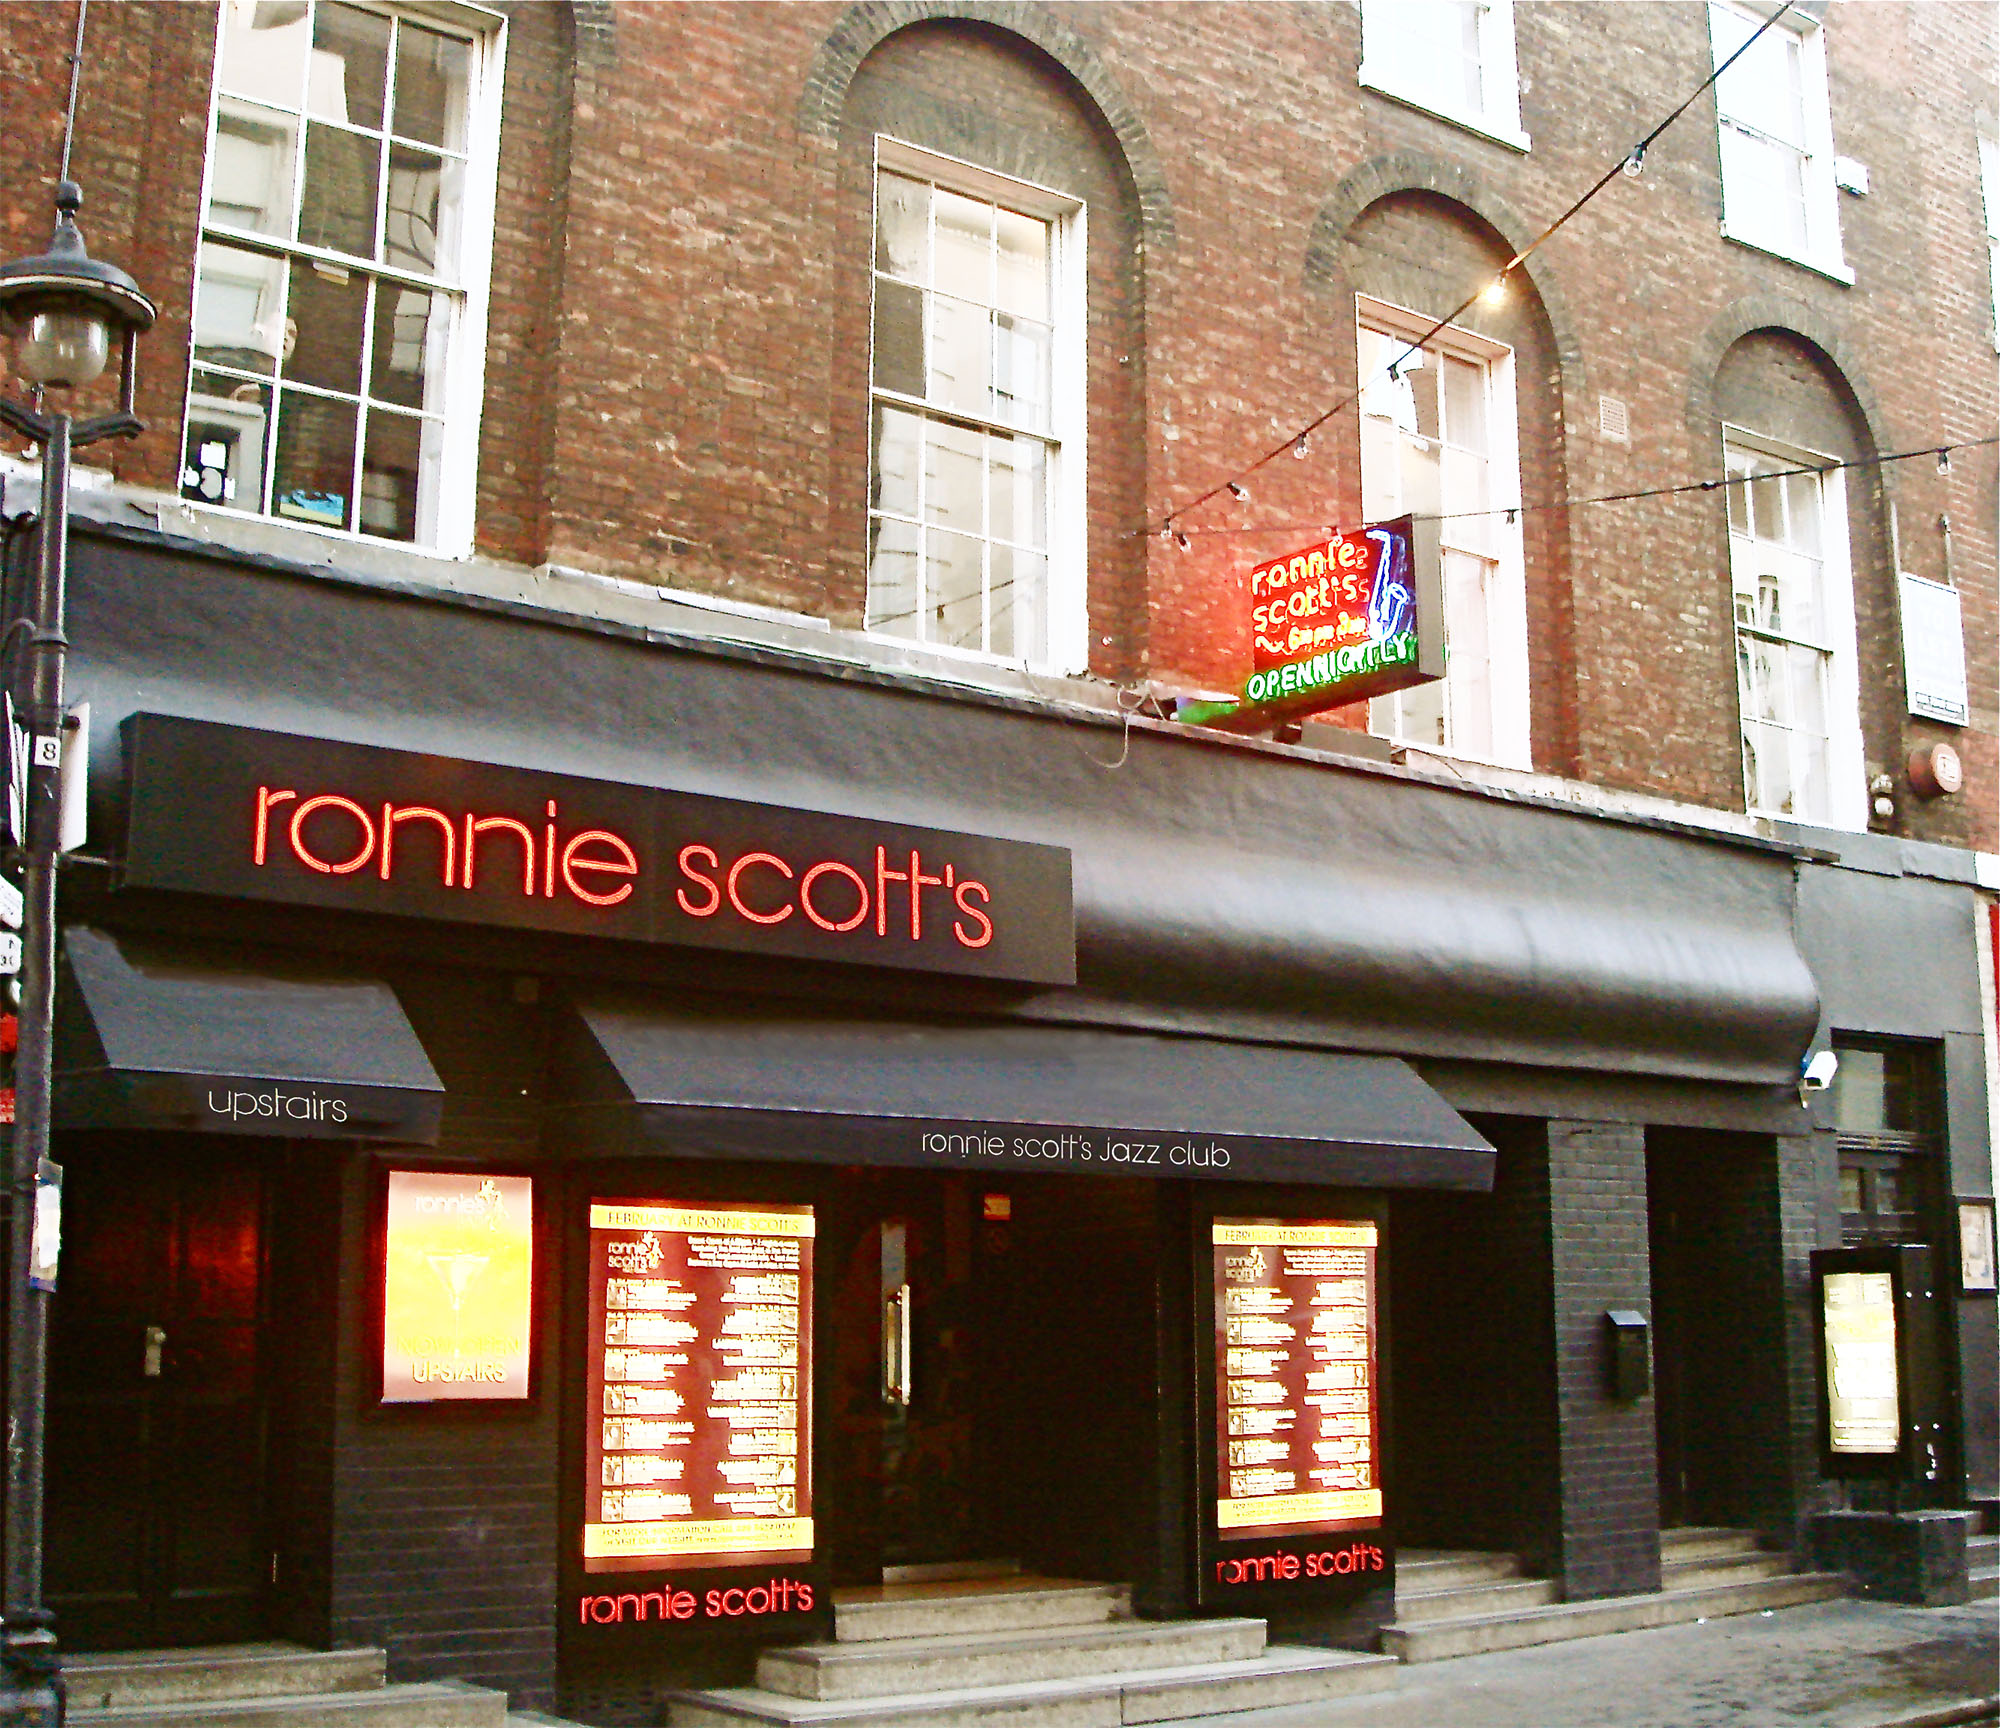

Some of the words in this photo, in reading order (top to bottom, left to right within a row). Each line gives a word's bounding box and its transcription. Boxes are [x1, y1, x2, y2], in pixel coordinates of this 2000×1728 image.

[1252, 536, 1355, 595] ronnie
[1252, 574, 1358, 632] scott's
[42, 742, 57, 761] 8
[255, 785, 638, 905] ronnie
[677, 845, 994, 948] scott's
[208, 1087, 348, 1123] upstairs
[922, 1130, 1005, 1157] ronnie
[1013, 1134, 1092, 1160] scott's
[1099, 1136, 1161, 1165] jazz
[1169, 1140, 1231, 1168] club
[608, 1211, 676, 1228] FEBRUARY
[696, 1214, 747, 1231] RONNIE
[412, 1362, 508, 1384] UPSTAIRS
[1216, 1549, 1300, 1585] ronnie
[1306, 1541, 1384, 1578] scott's
[580, 1583, 698, 1625] ronnie
[705, 1577, 815, 1618] scott's
